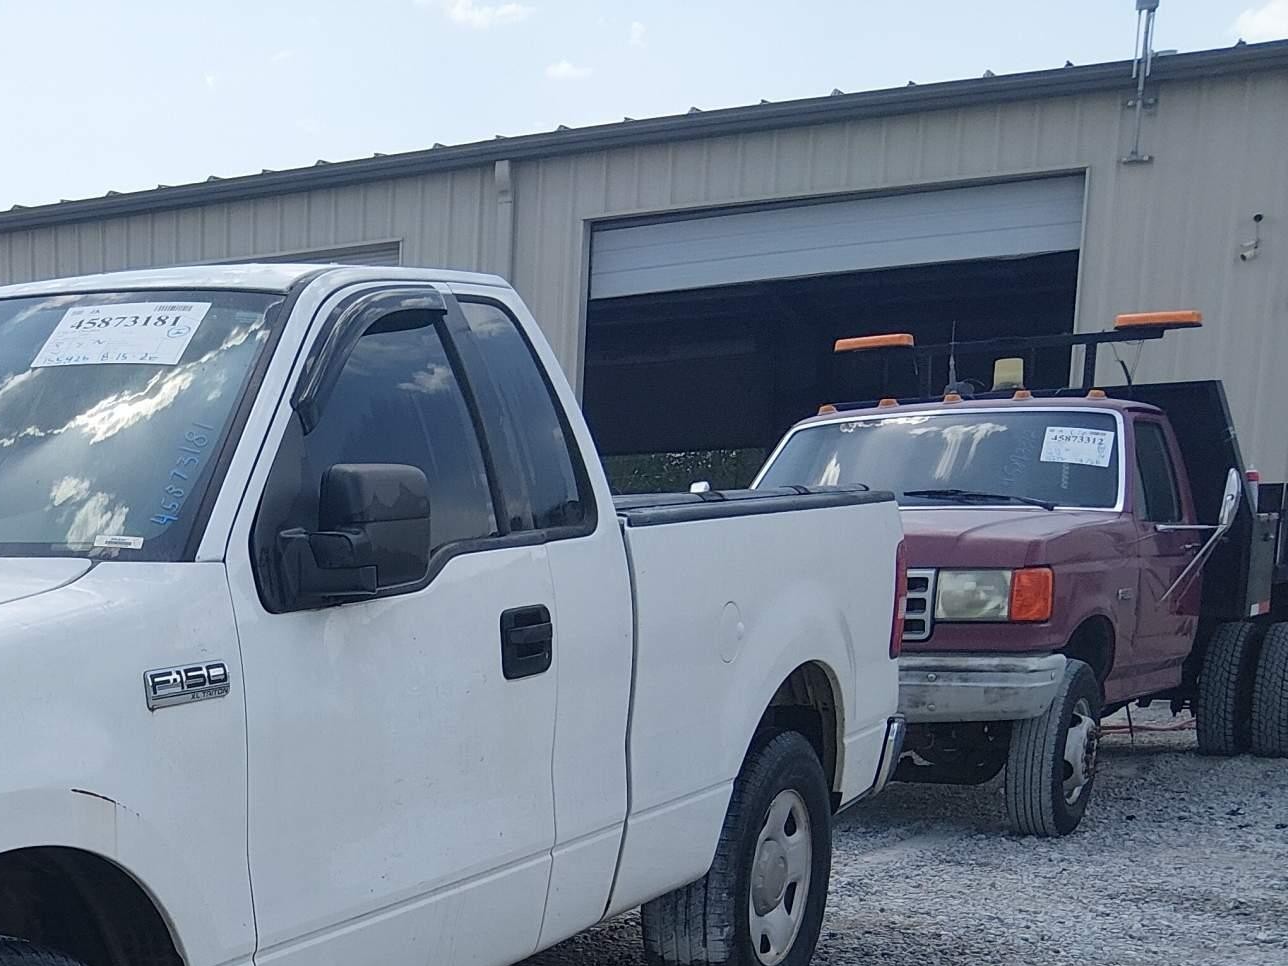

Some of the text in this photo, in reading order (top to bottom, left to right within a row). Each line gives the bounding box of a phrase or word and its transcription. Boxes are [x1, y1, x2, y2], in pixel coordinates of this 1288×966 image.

[70, 315, 182, 330] 45873181
[1050, 434, 1105, 446] 45873312
[150, 422, 214, 526] 45873181
